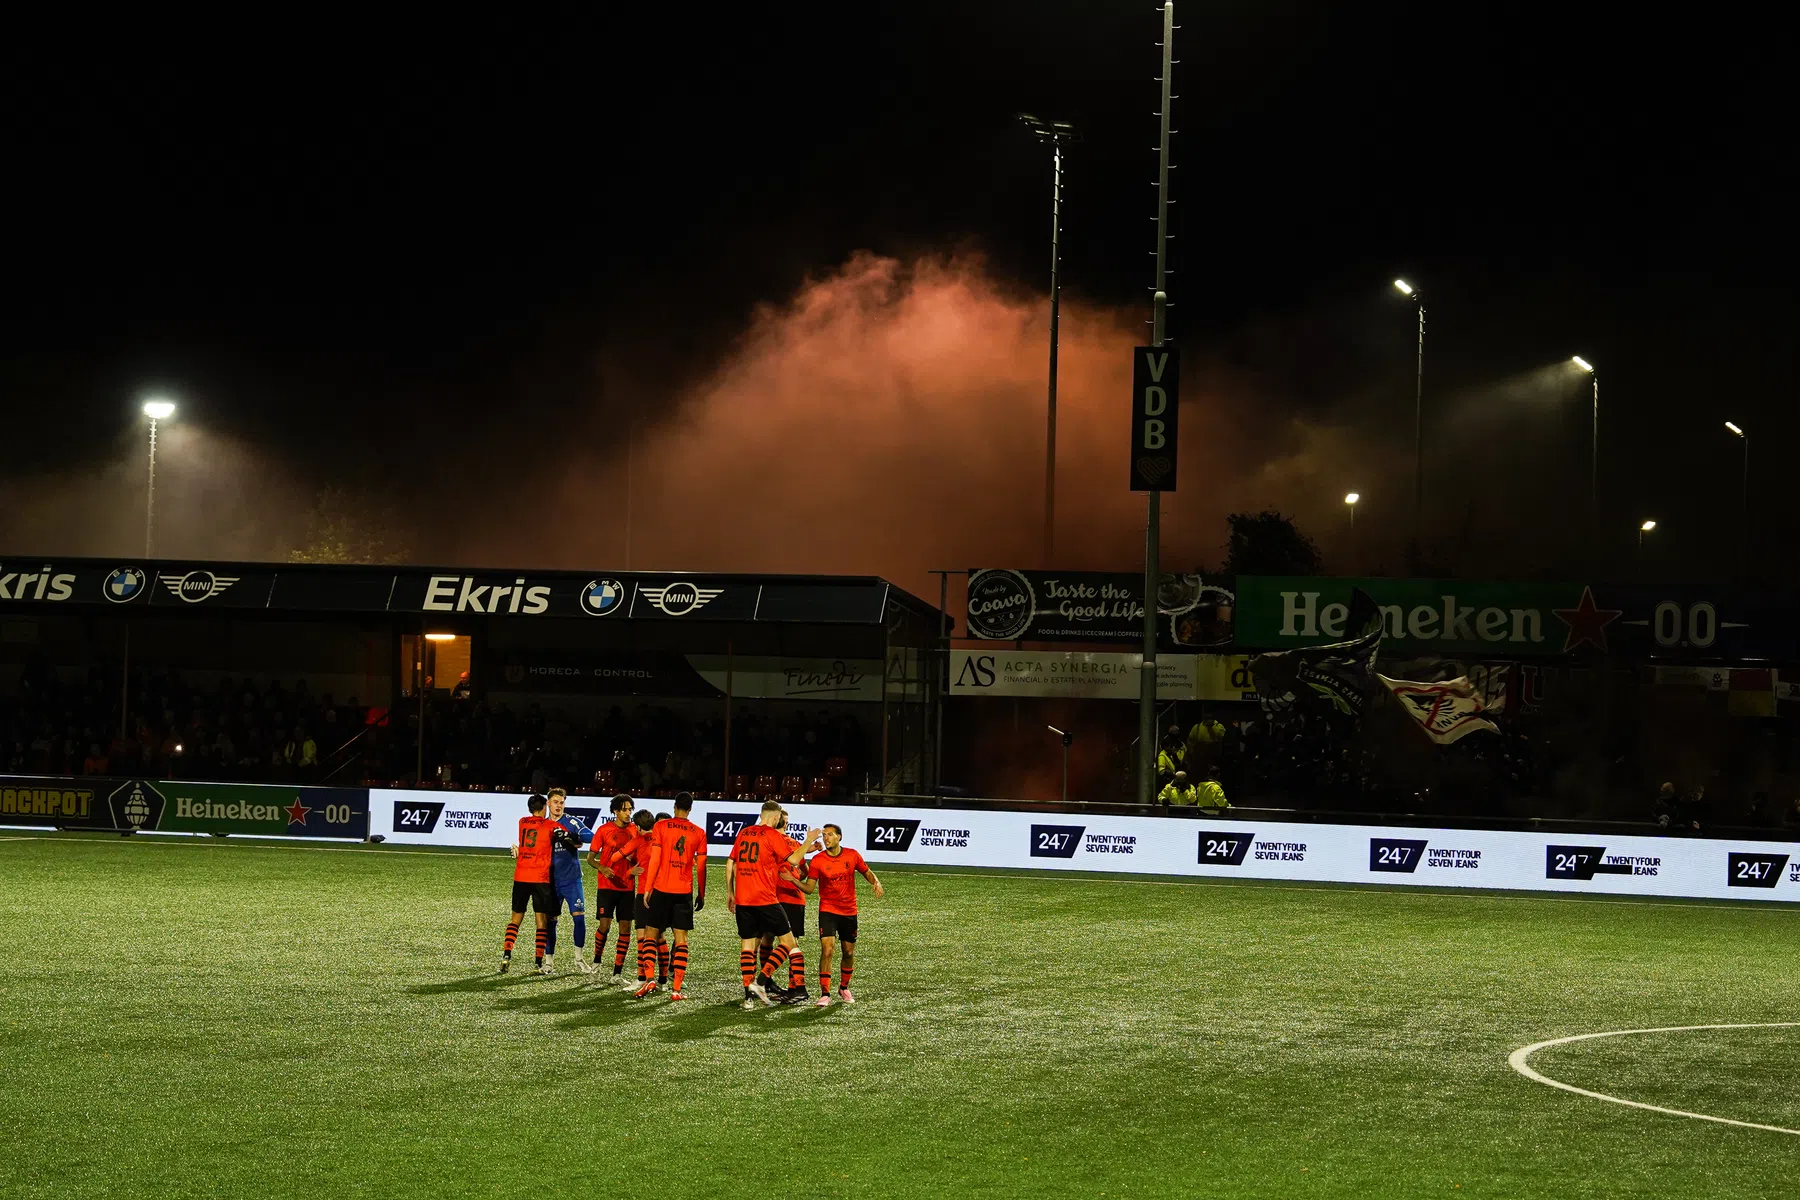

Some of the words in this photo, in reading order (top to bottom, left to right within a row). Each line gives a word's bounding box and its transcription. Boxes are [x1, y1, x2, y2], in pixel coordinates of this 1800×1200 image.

[183, 581, 211, 591] MINI
[1044, 580, 1098, 599] Taste
[1101, 583, 1131, 599] the
[422, 574, 551, 614] Ekris
[665, 593, 694, 603] MINI
[968, 594, 1029, 615] Coava
[1060, 600, 1108, 621] Good
[1110, 601, 1145, 621] Life
[1279, 591, 1545, 642] Heneken
[1654, 600, 1717, 648] 0.0
[529, 667, 581, 676] HORECA
[594, 668, 653, 678] CONTROL
[1005, 661, 1043, 672] ACTA
[1051, 662, 1127, 674] SYNERGIA
[1004, 676, 1041, 684] FINANCIAL
[1044, 676, 1049, 684] &
[1051, 676, 1076, 684] ESTATE
[1078, 677, 1117, 685] PLANNING
[0, 788, 92, 817] ACKPOT
[176, 797, 280, 821] Heineken
[325, 804, 350, 824] 0.0
[401, 809, 430, 826] 247
[445, 810, 492, 820] TWENTYFOUR
[445, 820, 467, 828] SEVEN
[468, 821, 489, 829] JEANS
[667, 822, 688, 831] Ekris
[521, 828, 538, 848] 19
[874, 827, 905, 843] 247
[921, 828, 970, 838] TWENTYFOUR
[1086, 834, 1137, 844] TWENTYFOUR
[673, 835, 686, 856] 4
[920, 838, 944, 846] SEVEN
[945, 839, 968, 847] JEANS
[1038, 833, 1070, 850] 247
[1206, 840, 1238, 857] 247
[1255, 842, 1307, 852] TWENTYFOUR
[738, 841, 760, 863] 20
[1086, 844, 1109, 853] SEVEN
[1110, 845, 1134, 854] JEANS
[1378, 847, 1411, 864] 247
[1428, 849, 1481, 859] TWENTYFOUR
[1255, 852, 1279, 860] SEVEN
[1281, 853, 1304, 861] JEANS
[1428, 859, 1453, 868] SEVEN
[1454, 860, 1479, 868] JEANS
[1606, 855, 1661, 866] TWENTYFOUR
[1633, 867, 1658, 876] JEANS
[1737, 861, 1772, 880] 247
